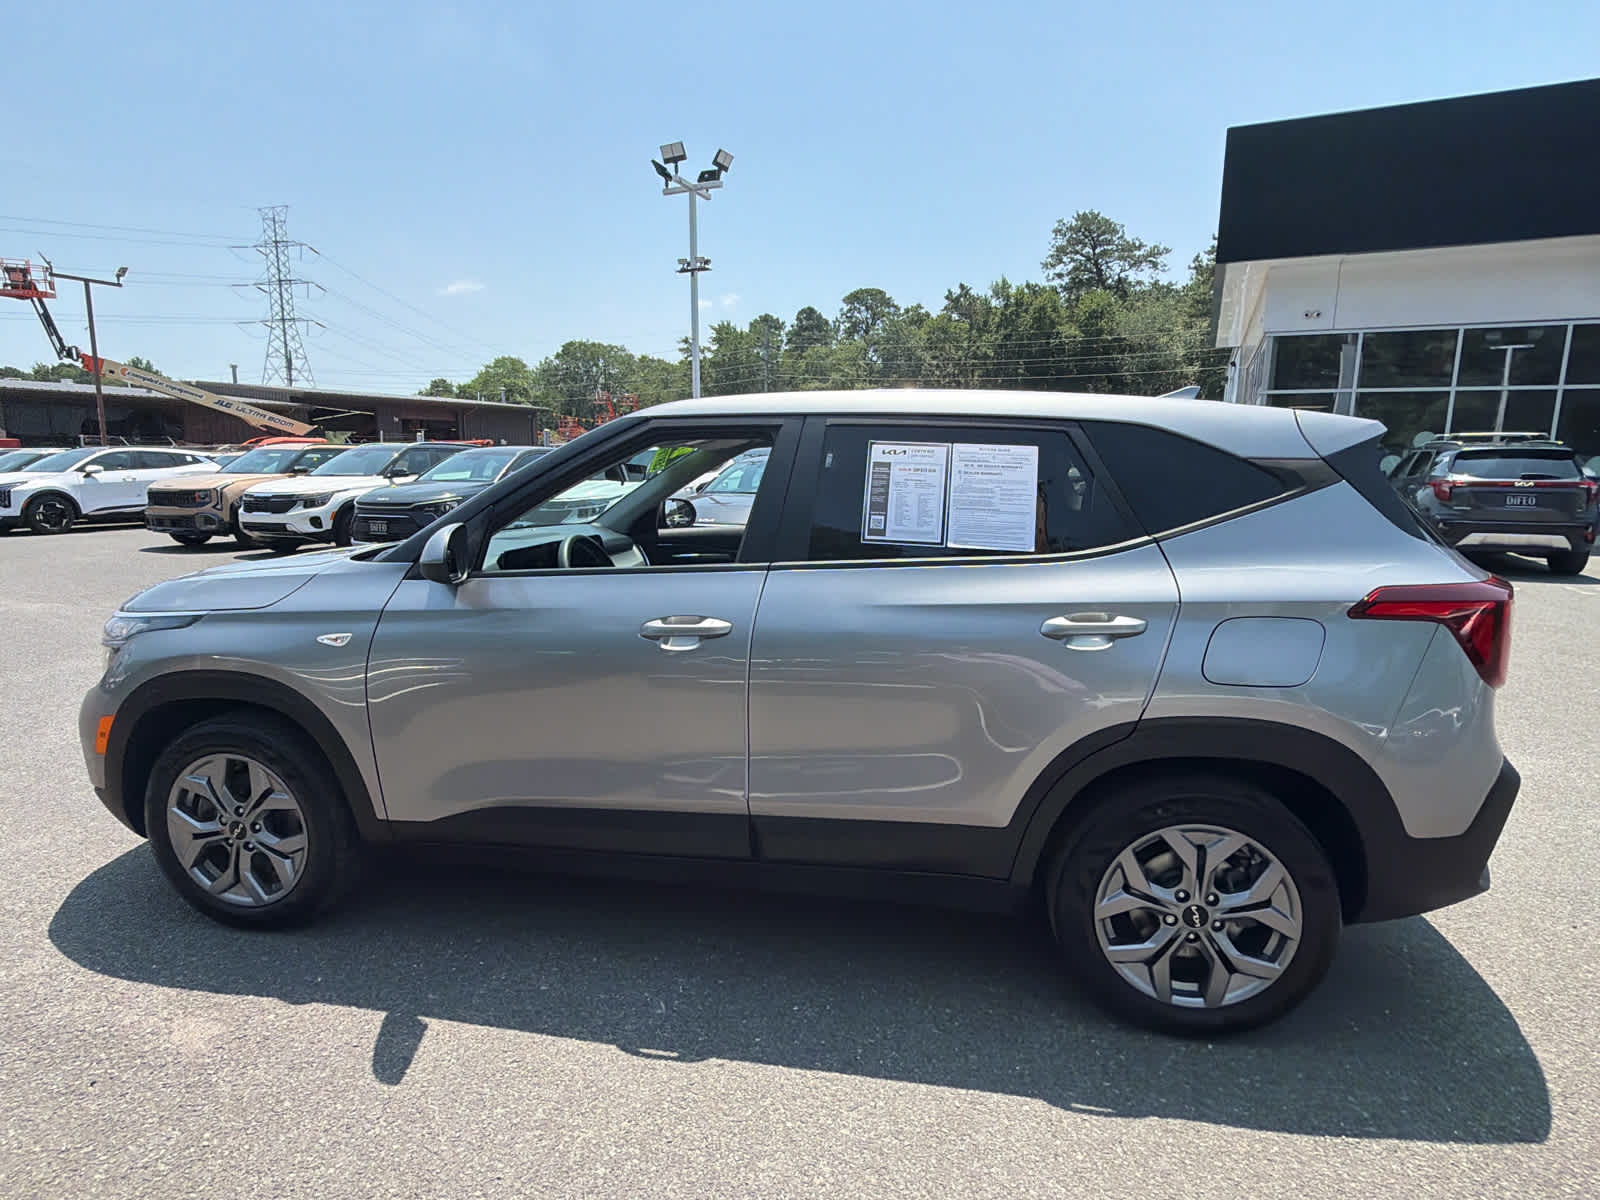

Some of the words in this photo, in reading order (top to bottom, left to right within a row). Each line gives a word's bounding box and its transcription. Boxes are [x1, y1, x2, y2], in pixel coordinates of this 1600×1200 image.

[214, 399, 233, 409] JLG
[235, 405, 267, 419] ULTRA
[267, 415, 295, 429] BOOM
